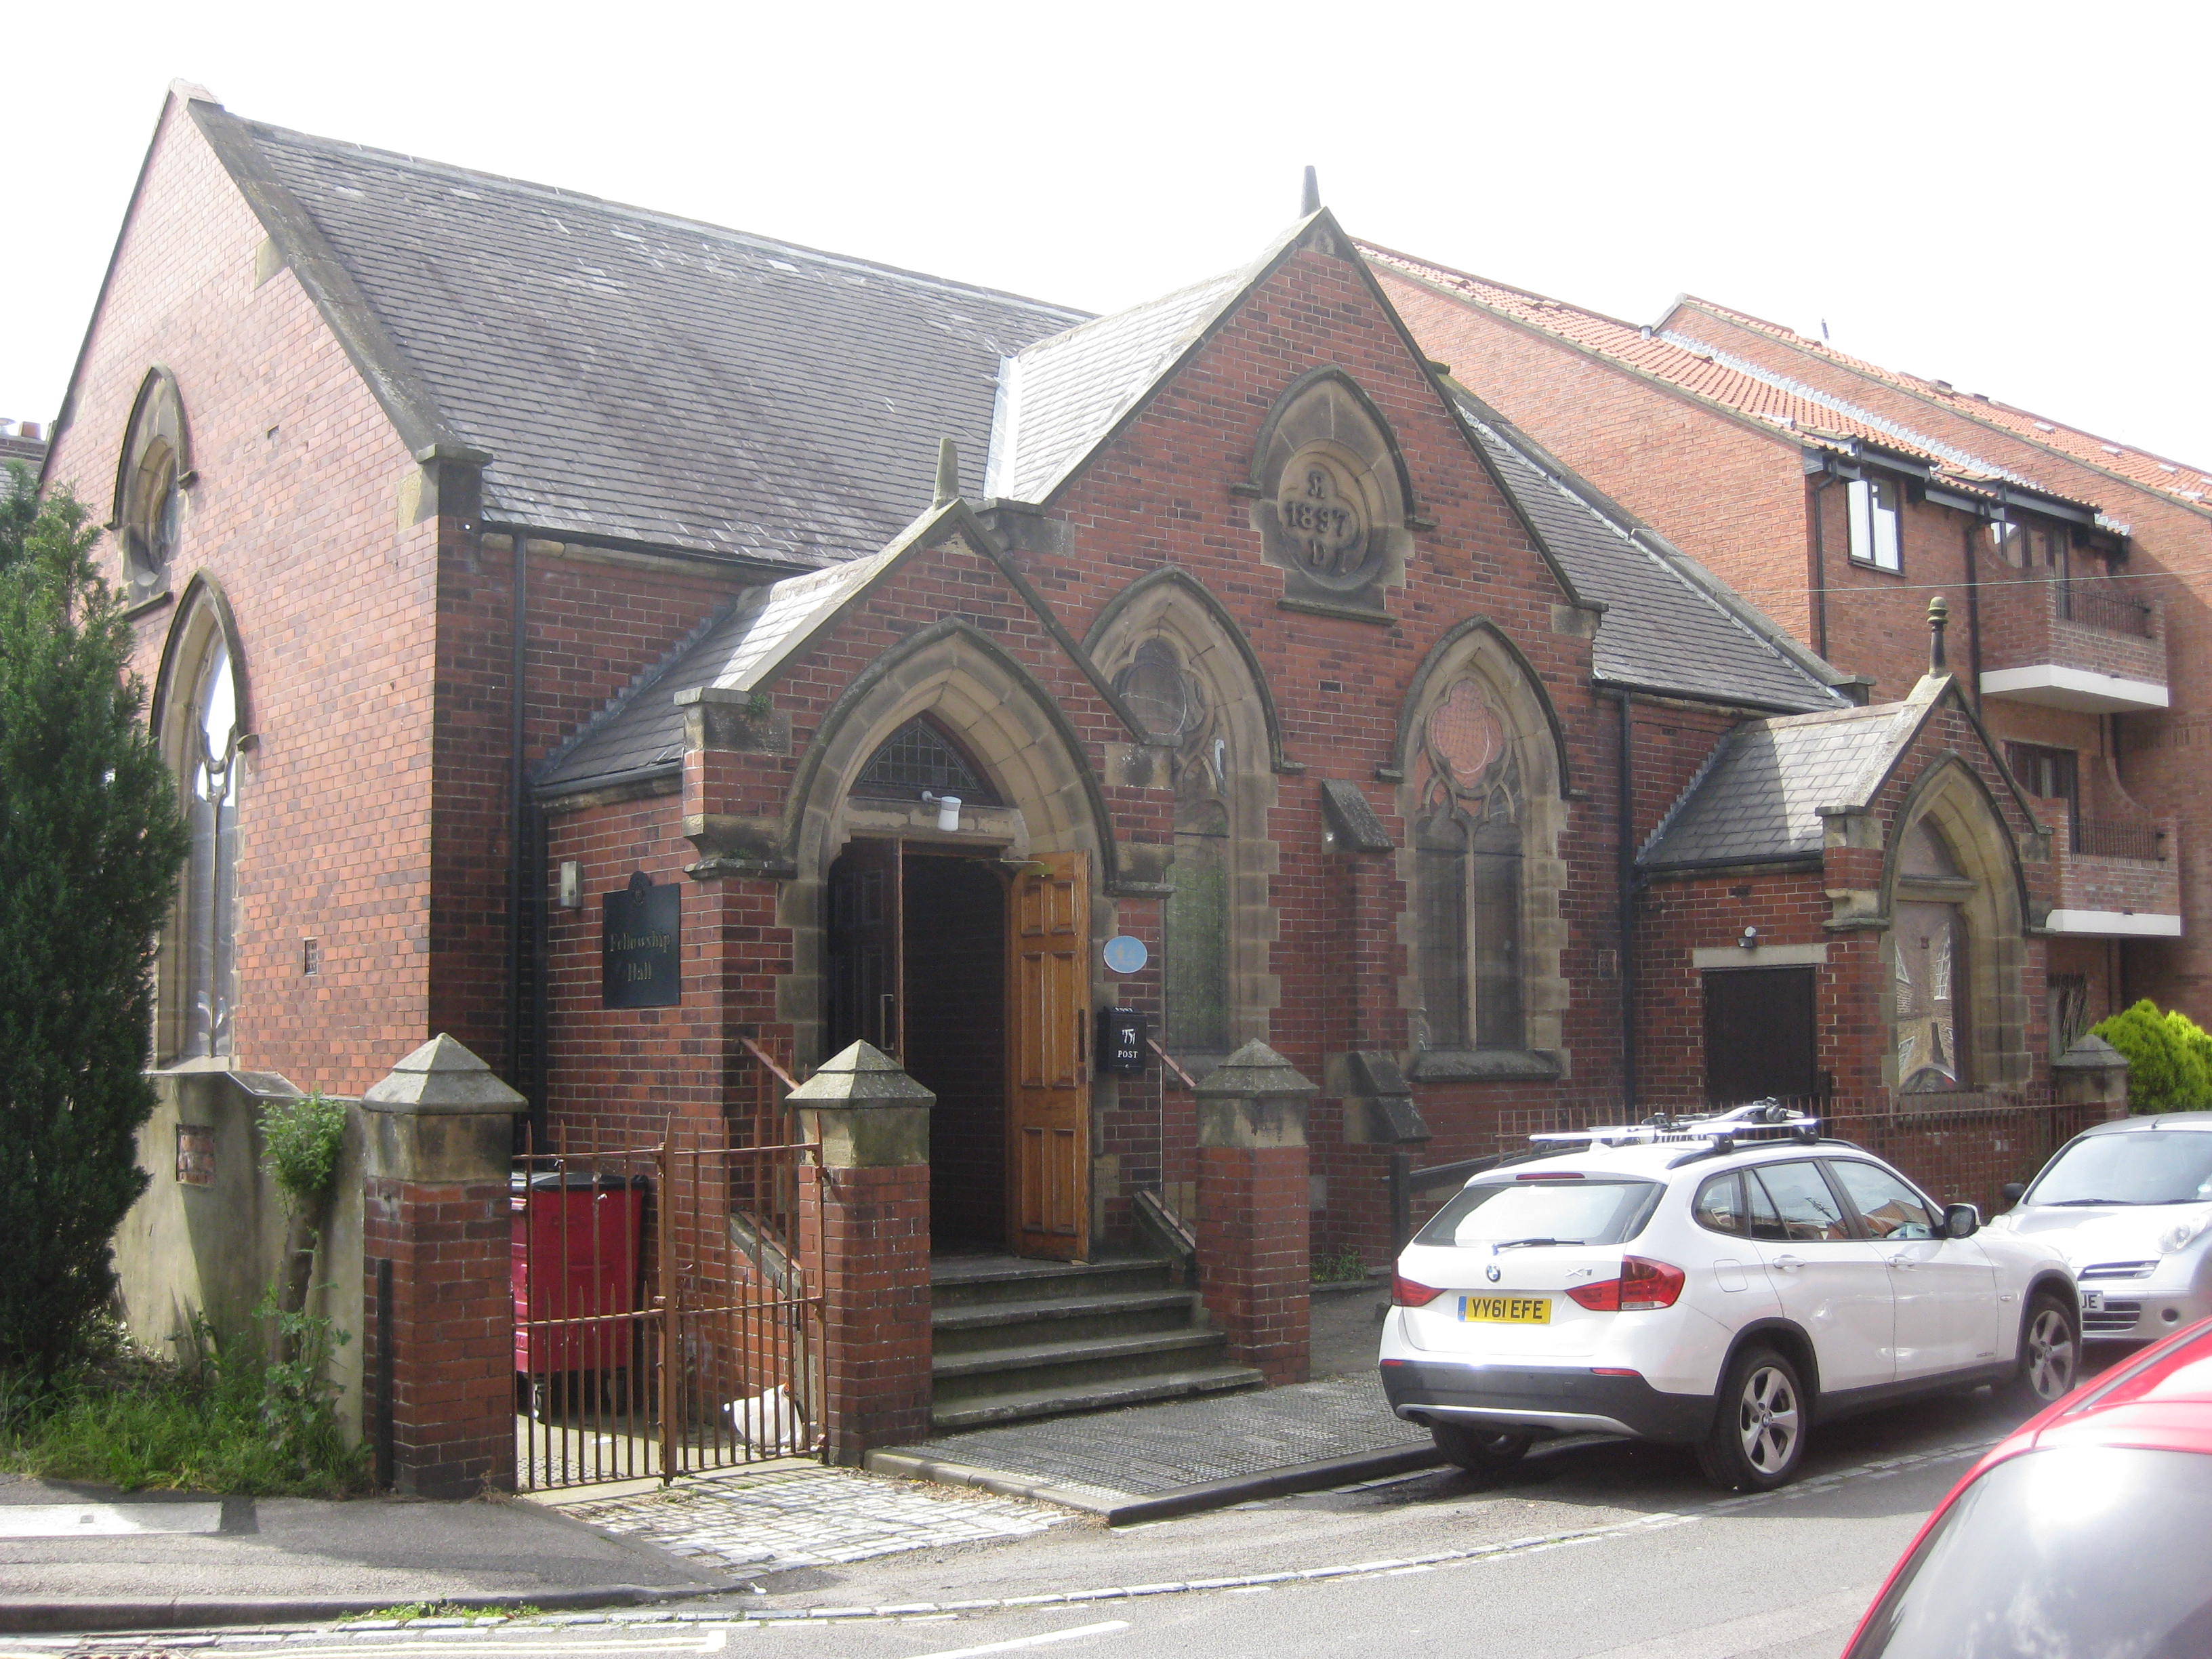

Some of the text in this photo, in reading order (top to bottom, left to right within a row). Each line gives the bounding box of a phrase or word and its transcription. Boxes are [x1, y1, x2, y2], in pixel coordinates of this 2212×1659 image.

[1285, 500, 1349, 539] 1897
[610, 930, 671, 954] Fellowship
[628, 961, 651, 983] Hall
[1118, 1050, 1139, 1059] POST
[1565, 1268, 1593, 1277] X1
[1472, 1298, 1544, 1319] YY61 EFE
